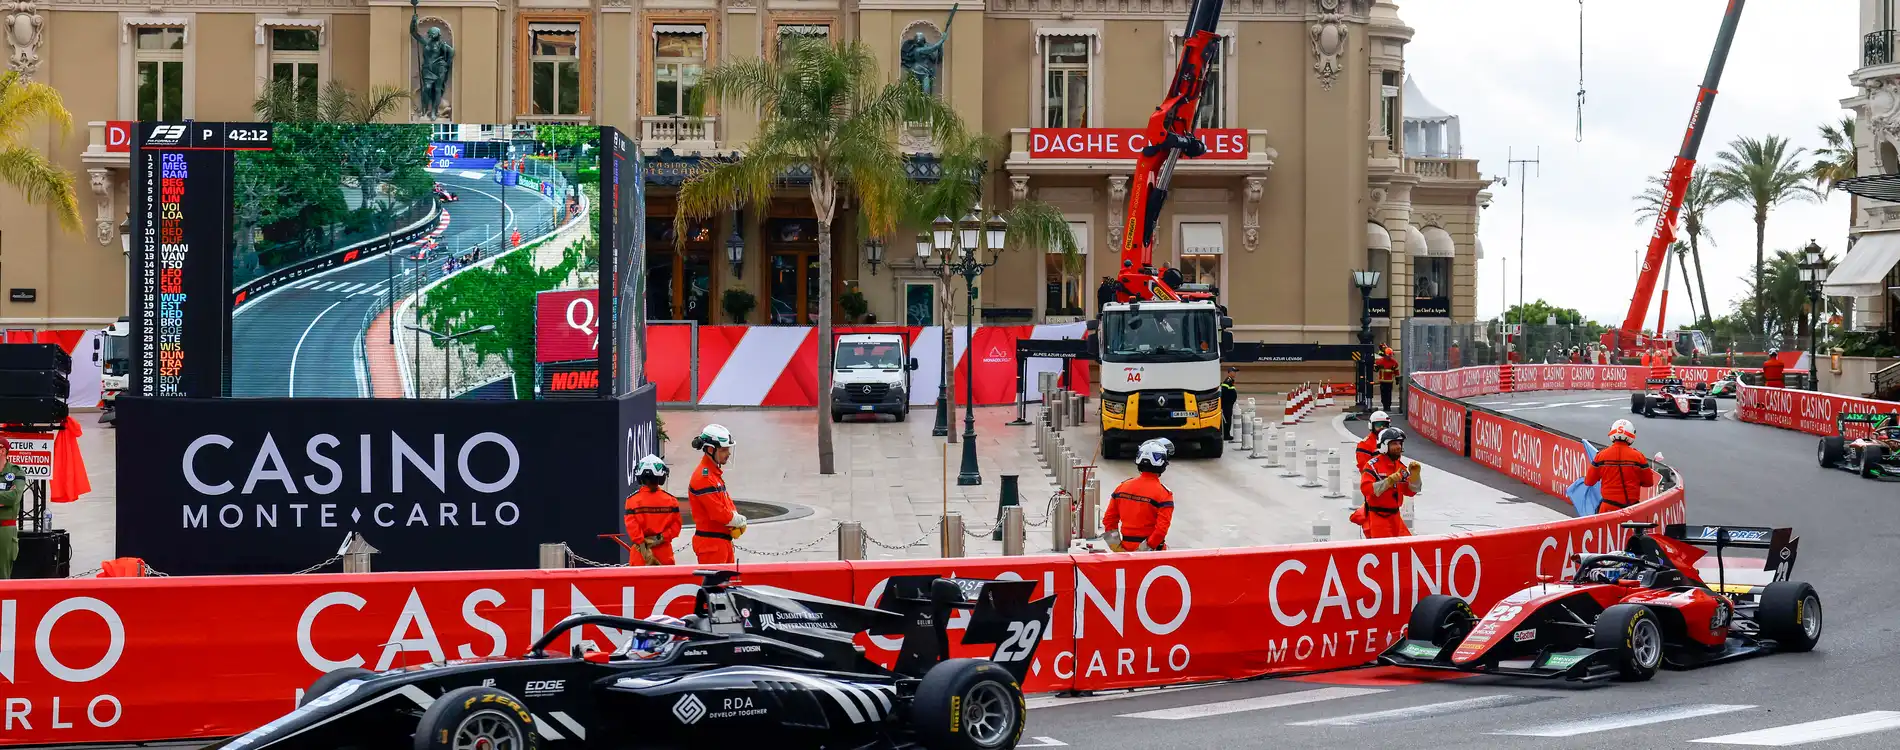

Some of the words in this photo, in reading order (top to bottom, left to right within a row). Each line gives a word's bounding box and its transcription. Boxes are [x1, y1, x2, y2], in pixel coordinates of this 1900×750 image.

[1690, 100, 1702, 130] Piovano
[150, 125, 186, 139] F3
[203, 129, 212, 140] P
[229, 130, 268, 140] 42:12
[1034, 134, 1118, 153] DAGHE
[1128, 134, 1244, 153] CLES
[1652, 190, 1674, 238] Piovano
[1127, 373, 1141, 382] A4
[1517, 368, 1537, 382] CASINO
[1543, 367, 1564, 380] CASINO
[1571, 368, 1594, 380] CASINO
[1602, 368, 1627, 381] CASINO
[1680, 369, 1708, 380] CASINO
[1764, 390, 1792, 414] CASINO
[1800, 396, 1831, 420] CASINO
[1442, 406, 1461, 437] CASINO
[1800, 420, 1814, 430] MONTE
[1817, 422, 1832, 433] CARLO
[1475, 418, 1502, 452] CASINO
[8, 455, 49, 463] TERVENTION
[1475, 448, 1488, 463] MONTE
[1490, 452, 1502, 468] CARLO
[1512, 430, 1542, 468] CASINO
[22, 467, 48, 475] RAVO
[183, 430, 520, 495] CASINO
[1552, 444, 1587, 481] CASINO
[1511, 462, 1526, 479] MONTE
[1527, 468, 1541, 486] CARLO
[184, 504, 337, 528] MONTE
[374, 502, 520, 527] CARLO
[1700, 526, 1768, 541] VADREY
[1269, 544, 1481, 627] CASINO
[1489, 605, 1523, 621] 23
[1628, 609, 1645, 635] ZERO
[993, 620, 1041, 662] 29
[1267, 628, 1378, 664] MONTE
[1054, 644, 1190, 679] CARLO
[526, 680, 566, 690] EDGE
[464, 697, 476, 709] P
[481, 694, 532, 724] ZERO
[724, 697, 754, 710] RDA
